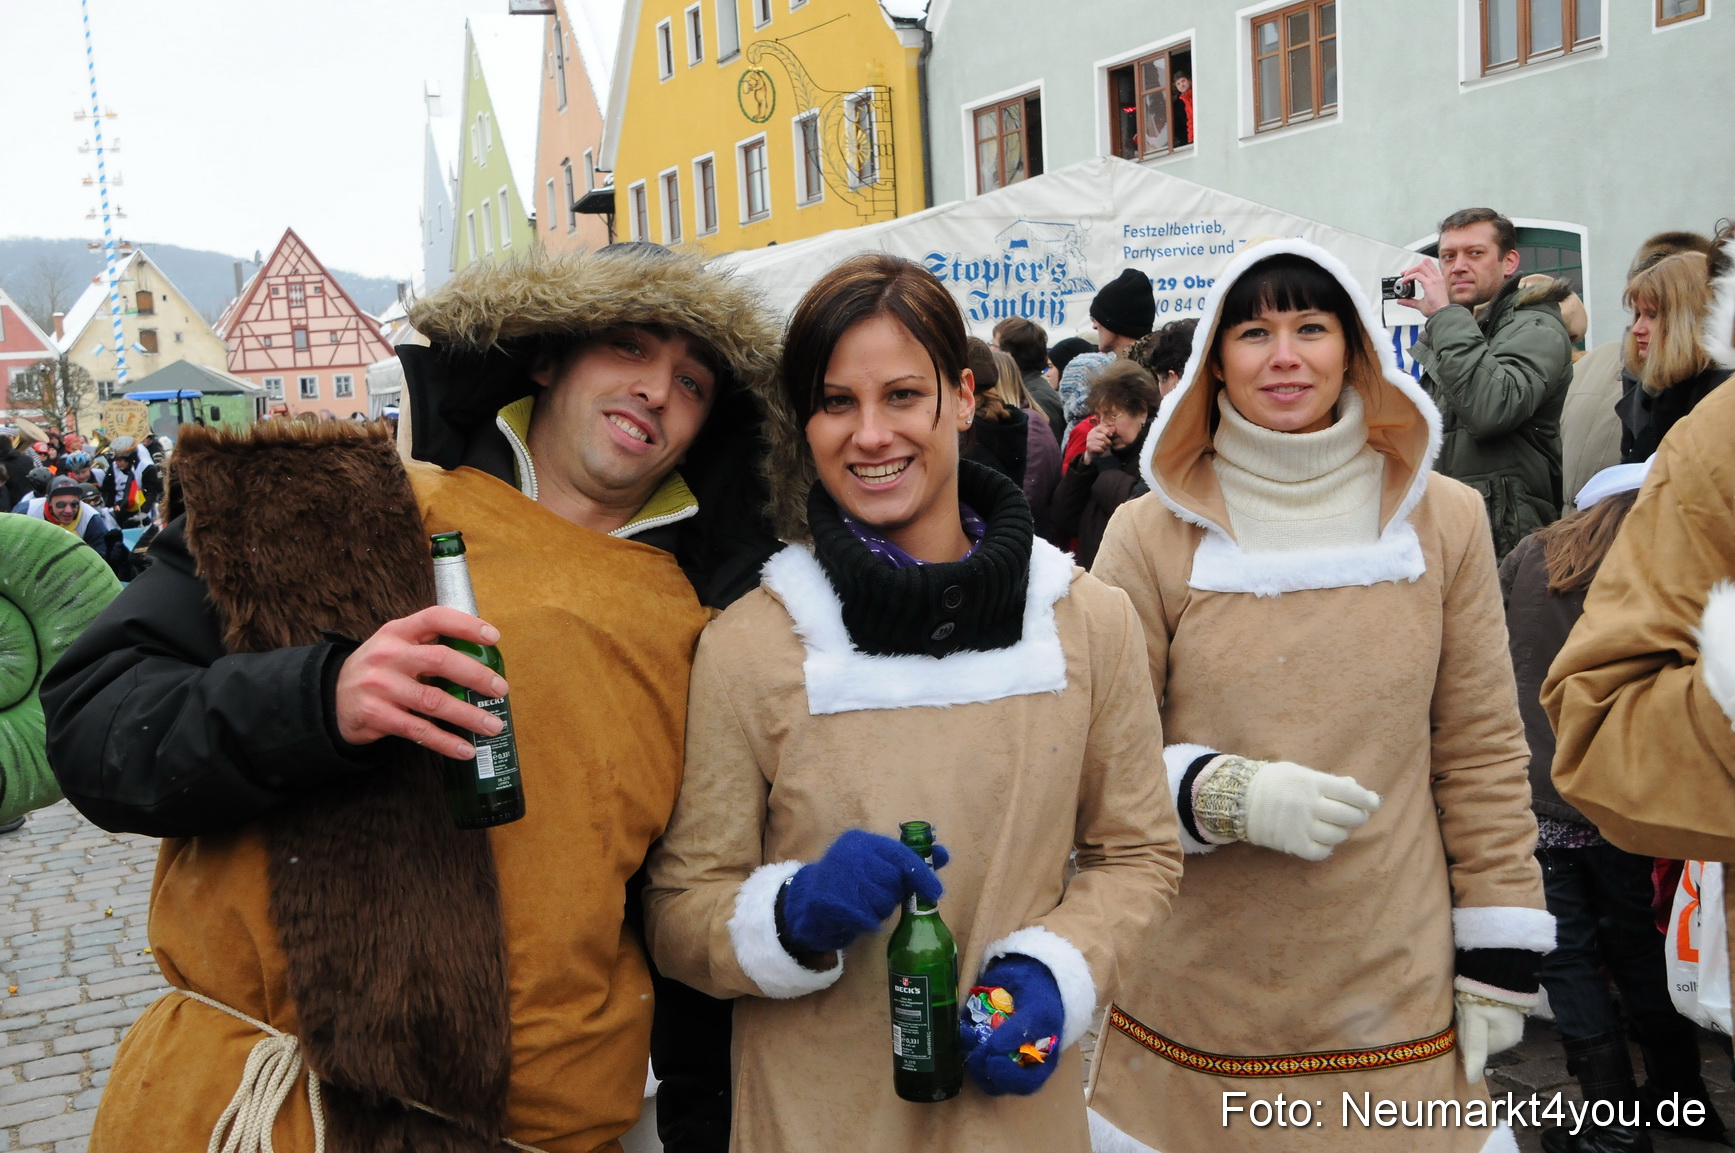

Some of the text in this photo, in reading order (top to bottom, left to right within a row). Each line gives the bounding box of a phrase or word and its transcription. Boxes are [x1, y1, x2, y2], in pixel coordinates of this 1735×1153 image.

[1123, 219, 1226, 239] Festzeltbetrieb,
[1123, 242, 1205, 262] Partyservice
[1209, 239, 1235, 255] und
[1151, 275, 1215, 292] 129 Obe
[1174, 297, 1192, 312] 84
[1197, 296, 1206, 311] 0
[477, 697, 505, 708] BECKS
[894, 984, 921, 995] BECK'S
[1675, 980, 1699, 993] soll
